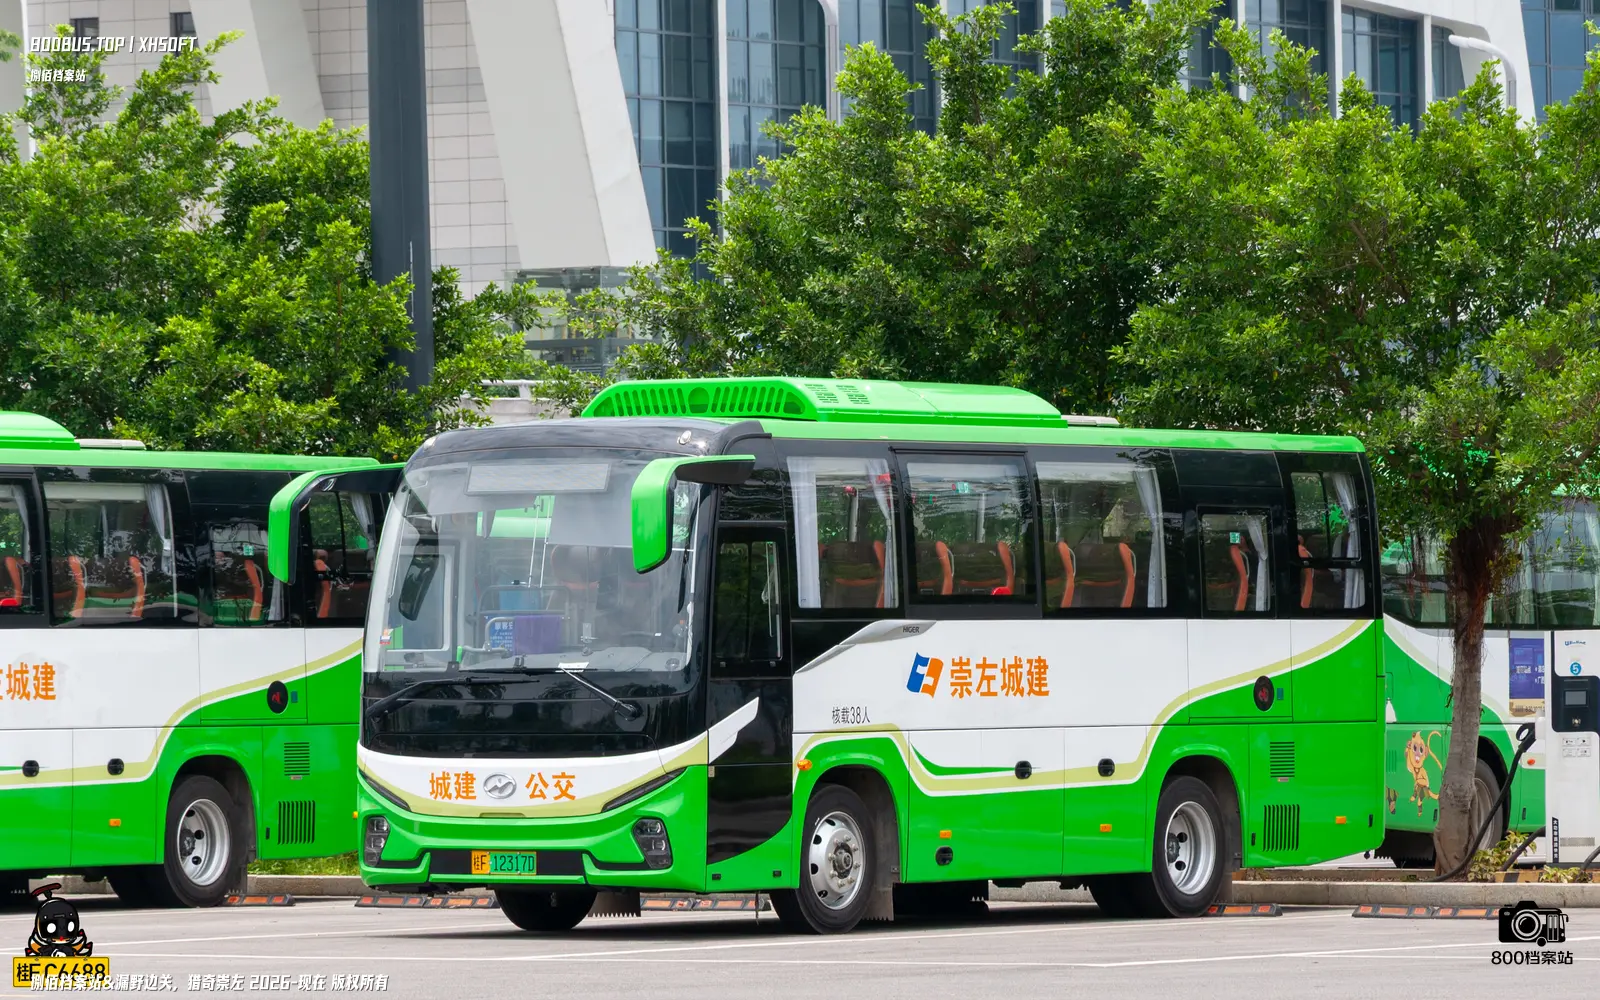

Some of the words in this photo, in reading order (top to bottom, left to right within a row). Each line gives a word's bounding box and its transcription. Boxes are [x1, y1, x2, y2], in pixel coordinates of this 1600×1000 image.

[902, 625, 920, 634] HIGER
[0, 661, 57, 701] 城建
[949, 655, 1050, 699] 崇左城建
[831, 706, 871, 725] 核载38人
[429, 771, 476, 801] 城建
[525, 771, 577, 801] 公交
